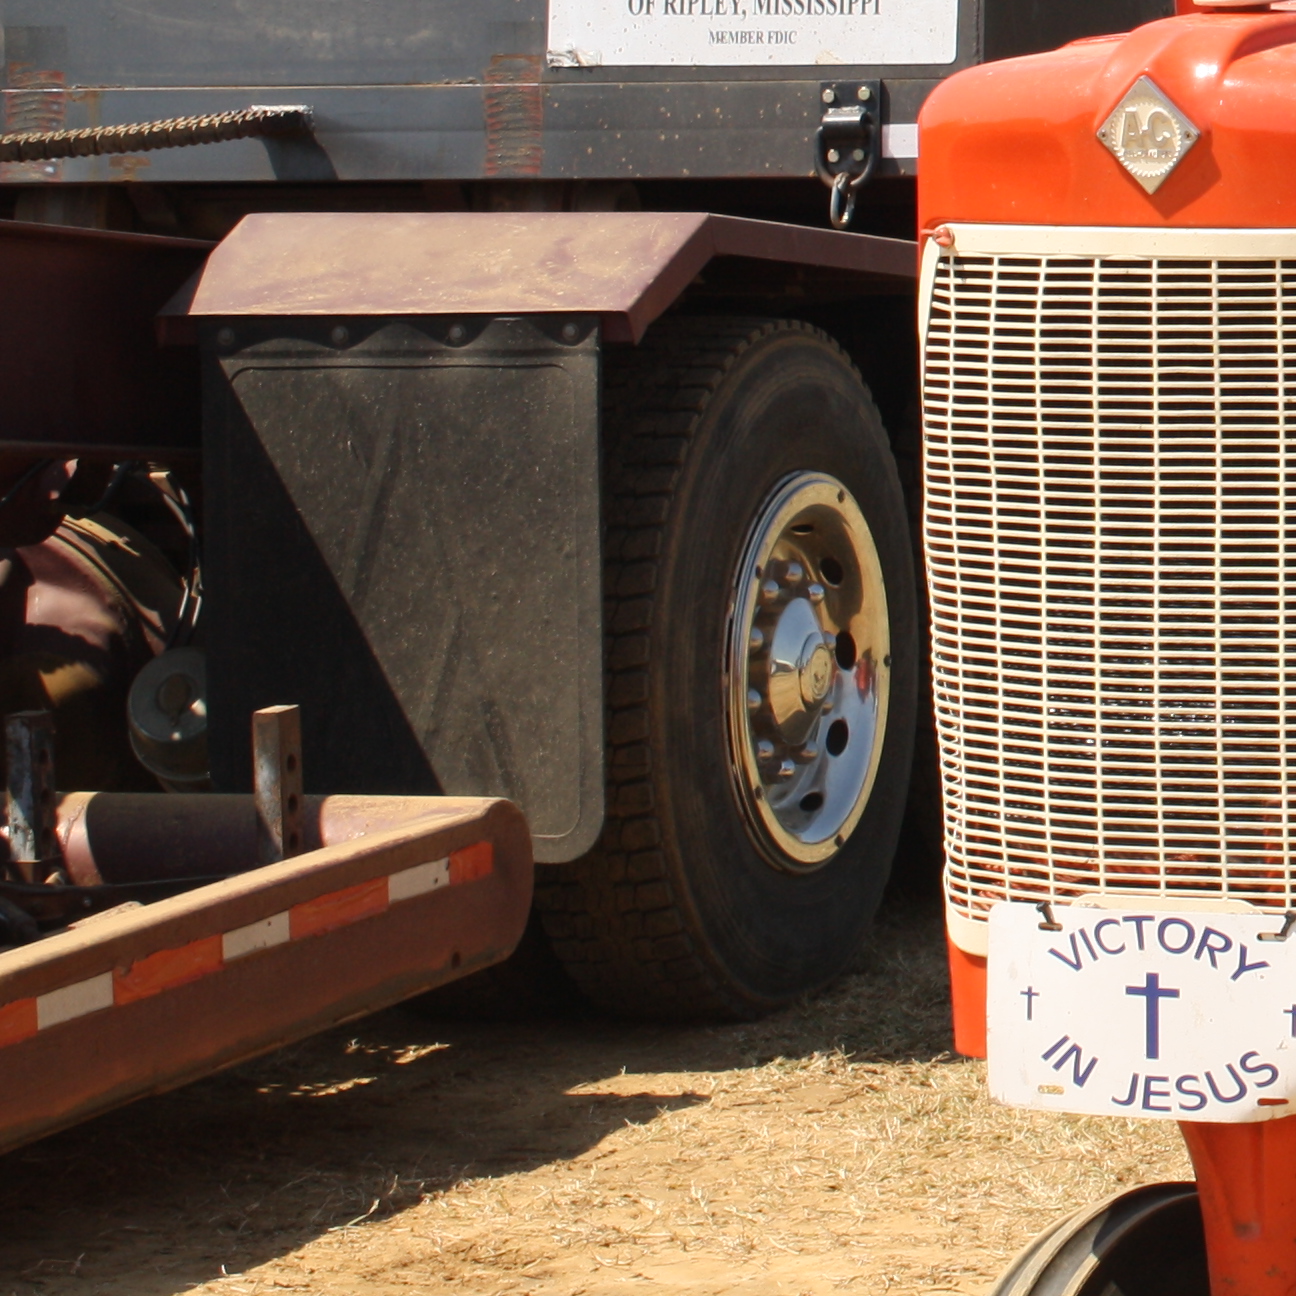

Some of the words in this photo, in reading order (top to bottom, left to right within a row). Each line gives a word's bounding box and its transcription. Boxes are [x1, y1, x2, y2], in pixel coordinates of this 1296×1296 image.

[708, 29, 764, 45] MEMBER
[767, 29, 798, 45] FDIC
[1048, 915, 1270, 981] VICTORY
[1041, 1034, 1098, 1088] IN
[1111, 1050, 1279, 1112] JESUS
